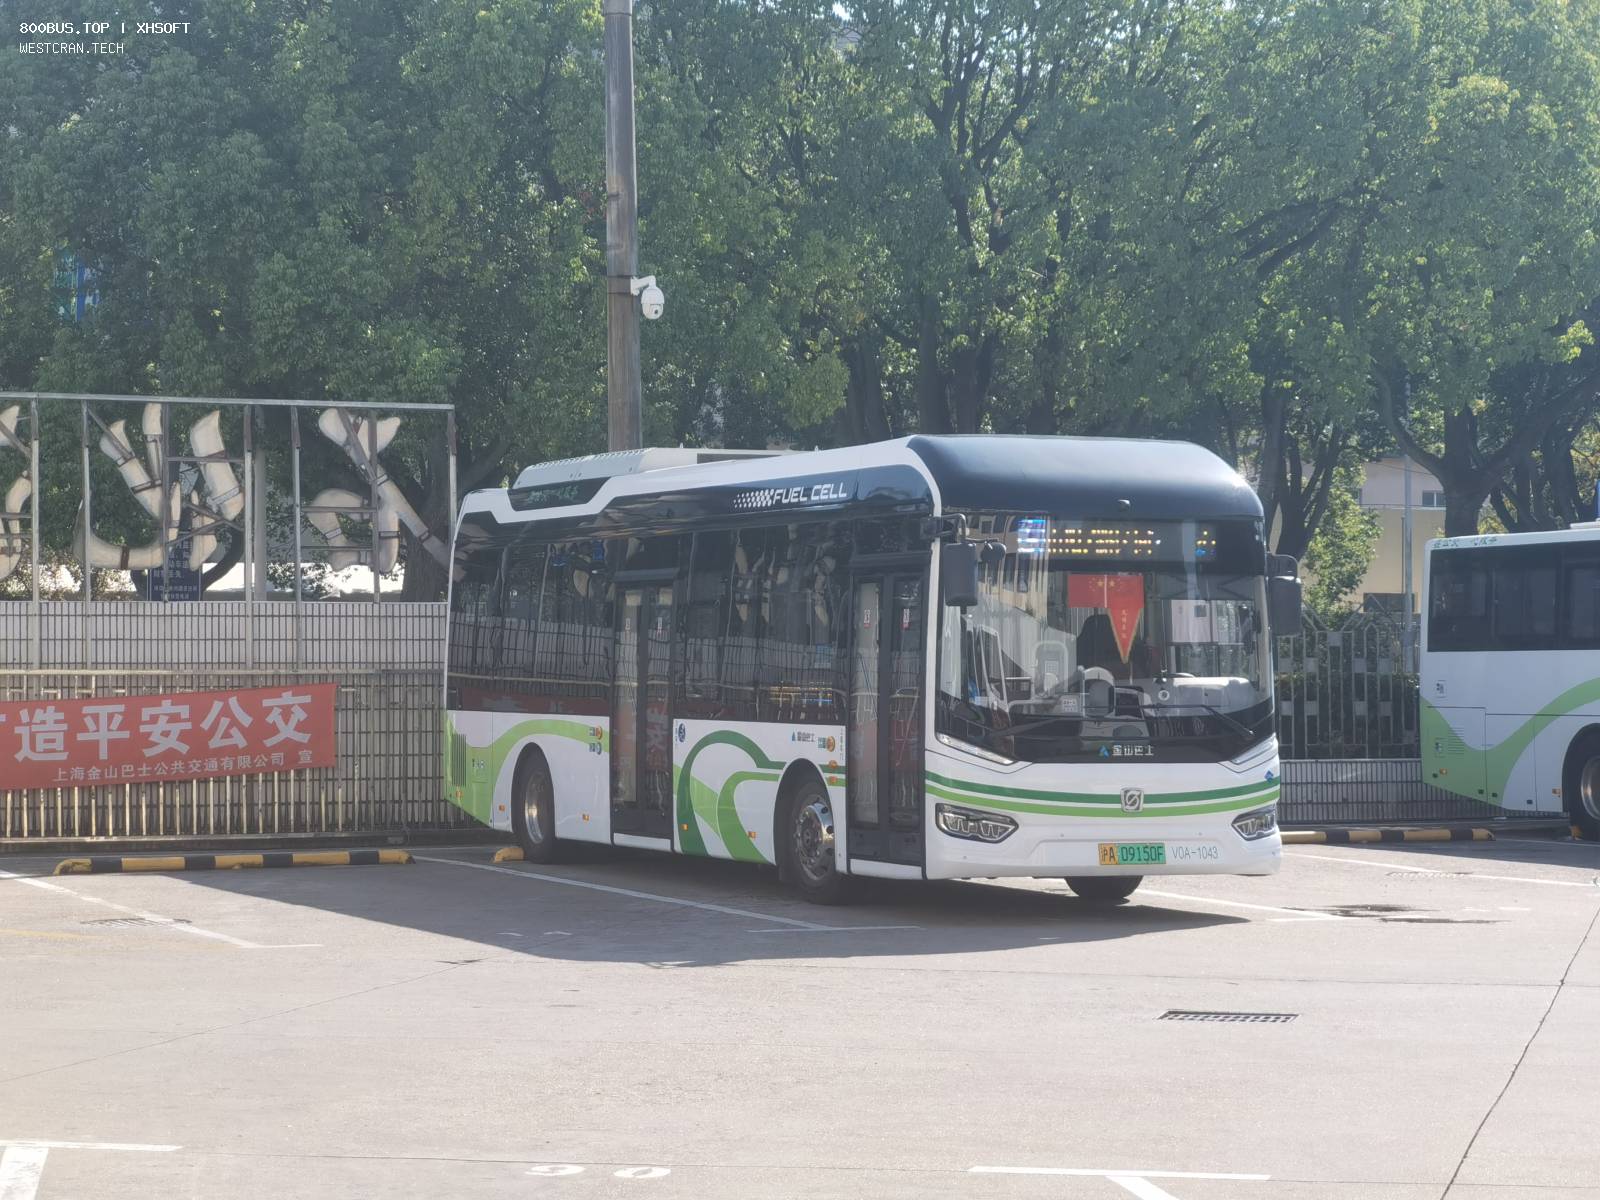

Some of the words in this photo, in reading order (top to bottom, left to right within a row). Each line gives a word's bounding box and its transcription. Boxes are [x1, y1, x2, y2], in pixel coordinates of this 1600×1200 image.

[773, 486, 808, 505] FUEL
[811, 482, 848, 501] CELL
[0, 690, 312, 763] 造平安公交
[1112, 744, 1154, 756] 金山巴士
[53, 752, 284, 782] 上海金山巴士公共交通有限公司
[298, 749, 313, 764] 宣
[1120, 846, 1164, 862] 09150F
